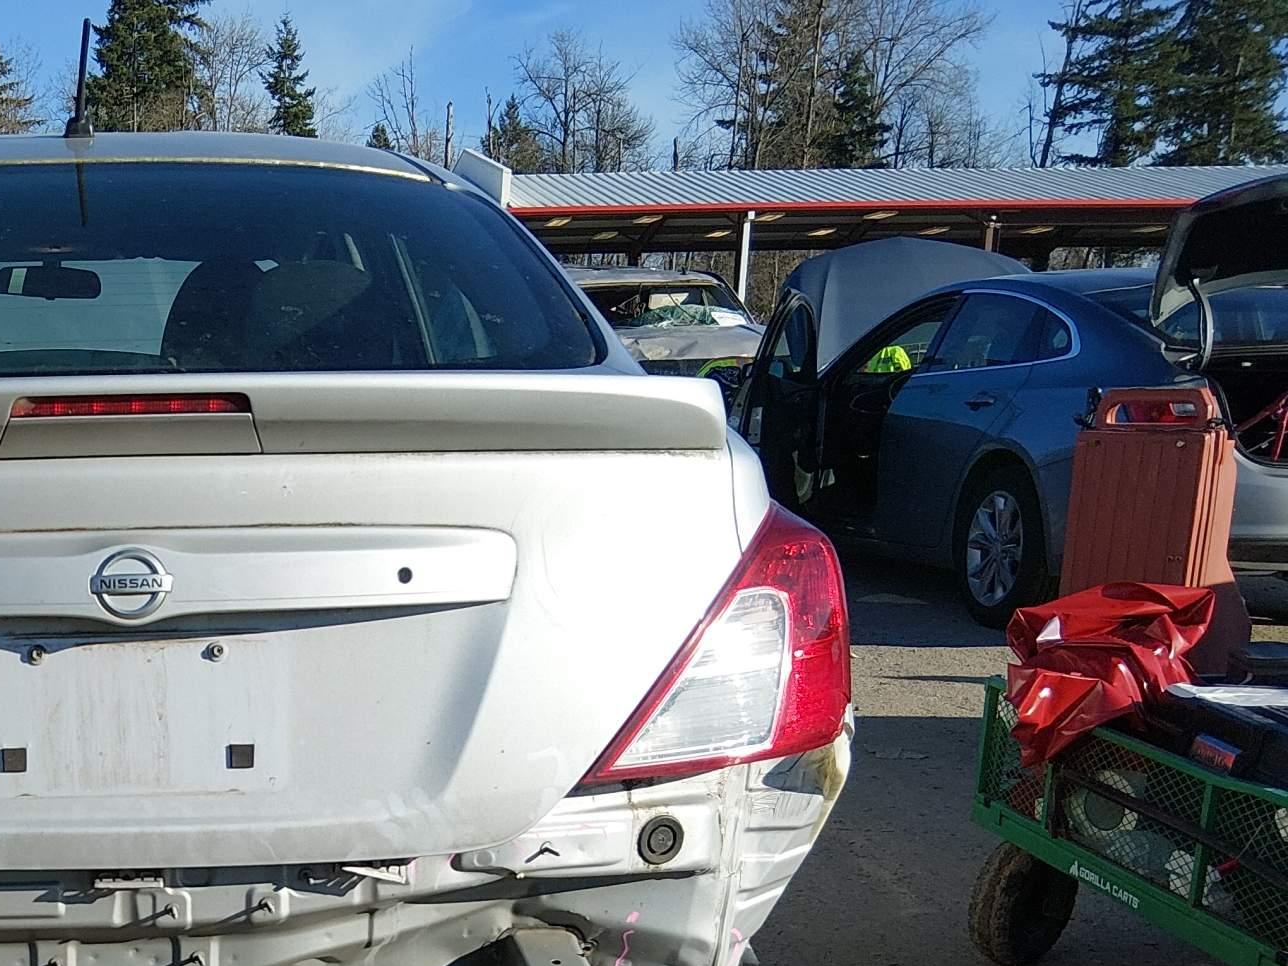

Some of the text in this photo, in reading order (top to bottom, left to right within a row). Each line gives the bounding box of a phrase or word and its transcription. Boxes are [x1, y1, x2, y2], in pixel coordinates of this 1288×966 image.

[100, 578, 163, 589] NISSAN
[1079, 867, 1139, 908] GORILLA CARTS
